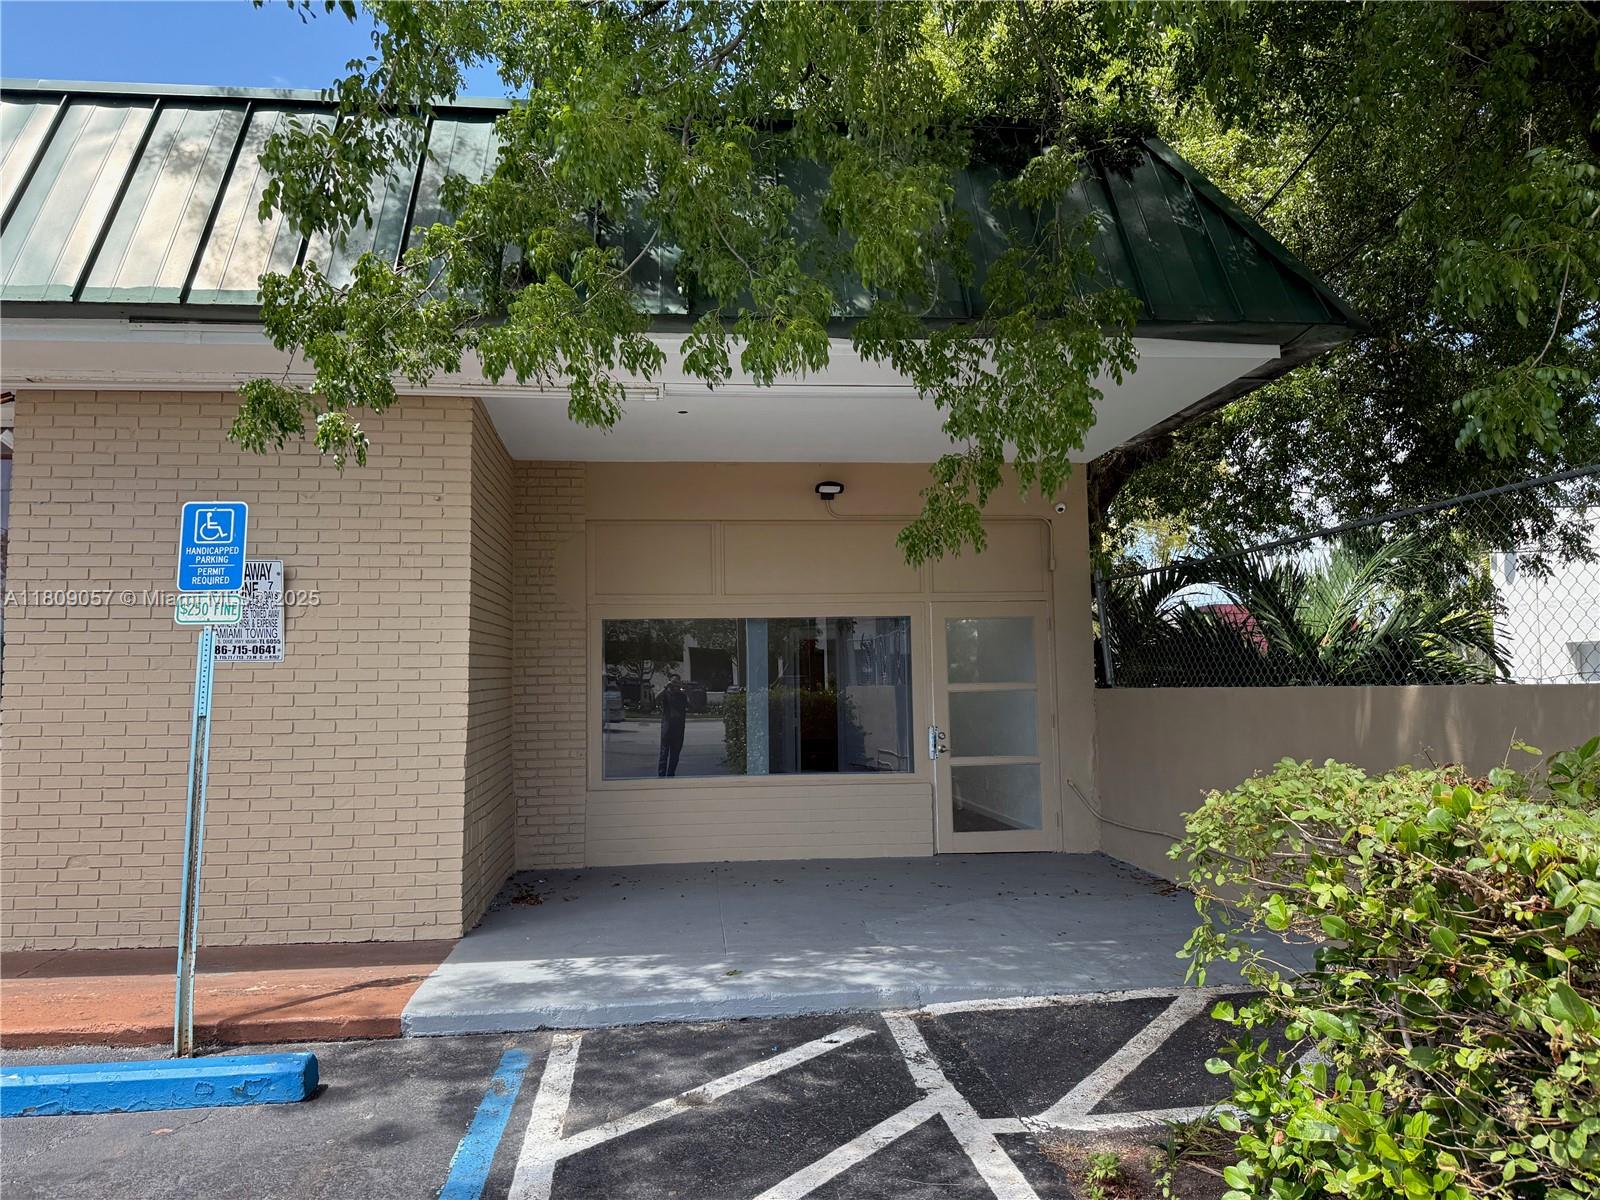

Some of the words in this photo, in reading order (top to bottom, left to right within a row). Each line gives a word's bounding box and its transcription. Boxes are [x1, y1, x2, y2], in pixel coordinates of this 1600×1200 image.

[185, 546, 240, 555] HANDICAPPED
[195, 555, 229, 564] PARKING
[197, 567, 225, 576] PERMIT
[244, 563, 272, 580] AWAY
[191, 576, 230, 585] REQUIRED
[267, 581, 274, 590] 7
[180, 602, 208, 616] $250
[214, 602, 238, 616] FINE
[250, 610, 266, 618] TOWED
[267, 610, 280, 618] AWAY
[256, 619, 278, 628] EXPENSE
[245, 628, 278, 638] TOWING
[214, 645, 276, 655] 86-715-0641
